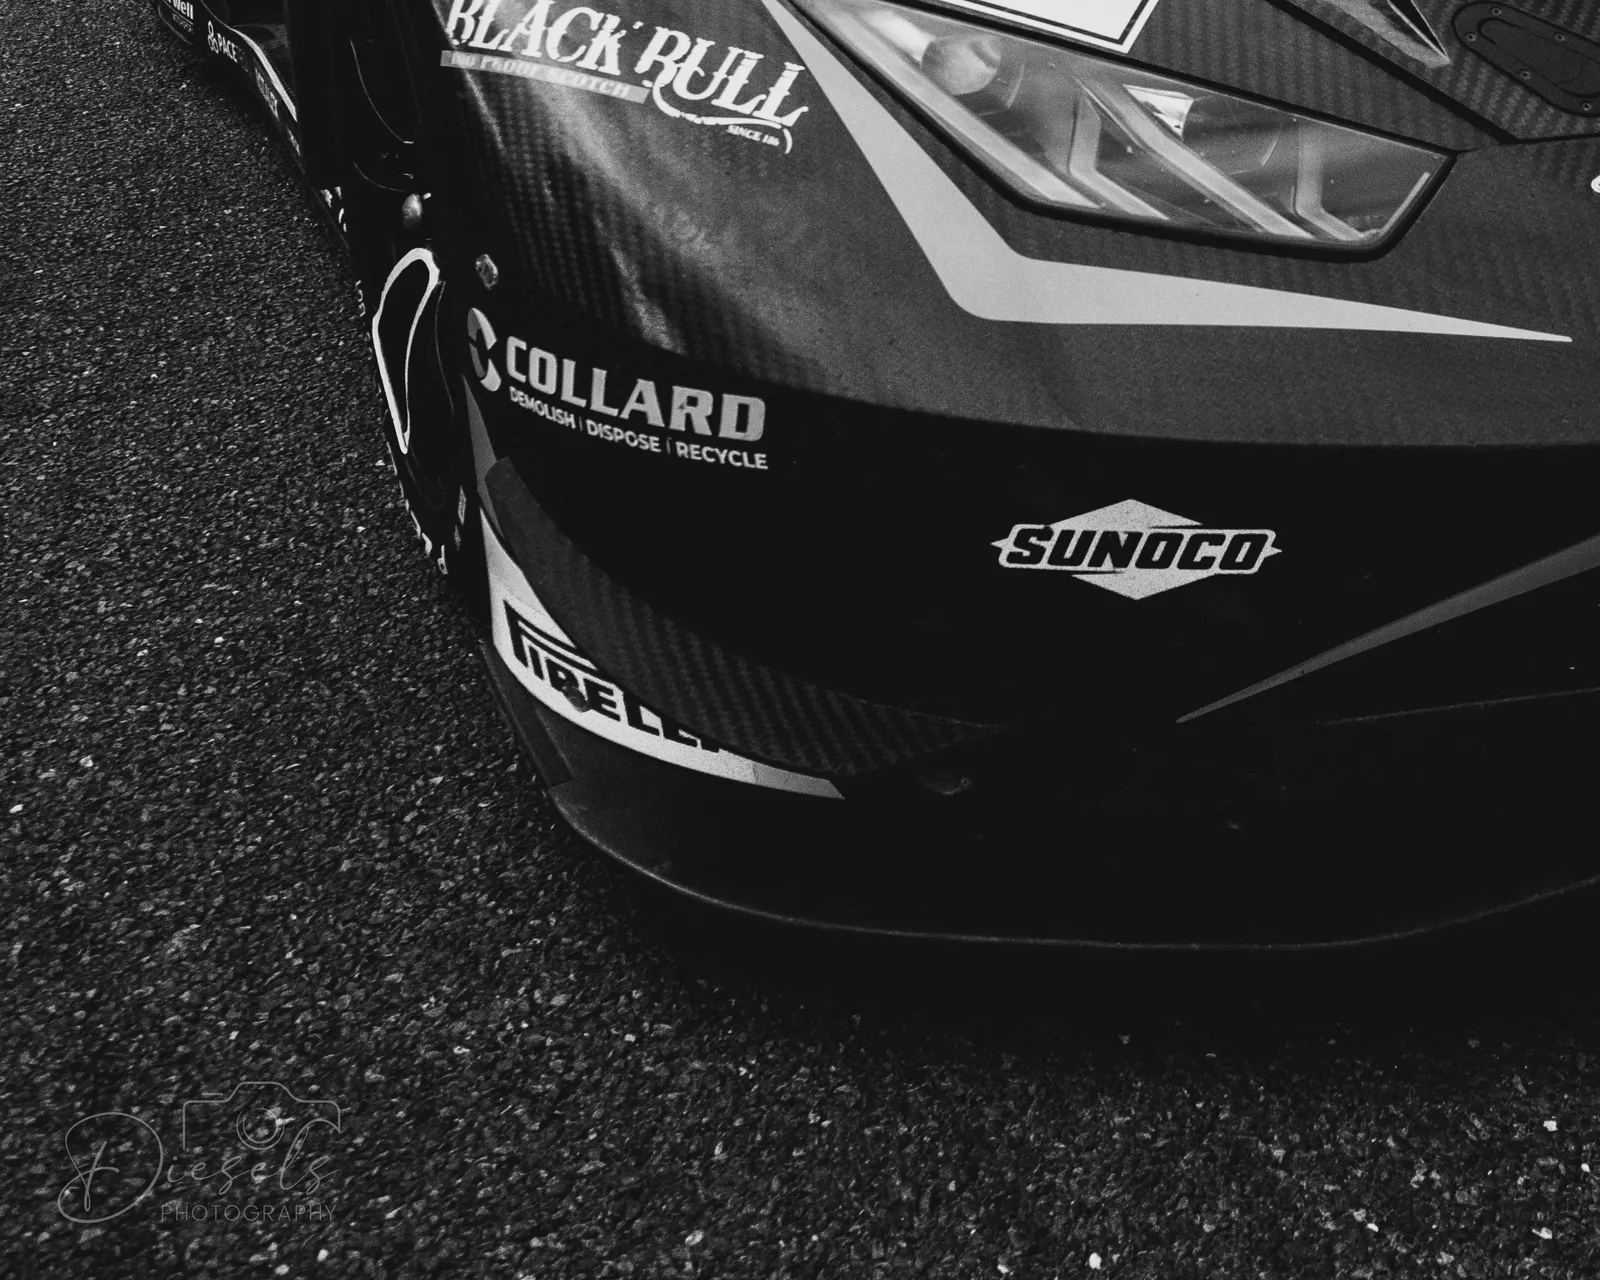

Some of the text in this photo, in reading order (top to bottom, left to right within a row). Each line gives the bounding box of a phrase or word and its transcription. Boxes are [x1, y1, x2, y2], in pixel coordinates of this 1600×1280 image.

[635, 24, 809, 128] BULL
[505, 334, 766, 443] COLLARD
[509, 383, 769, 471] DEMOLISH DISPOSE RECYCLE
[1006, 524, 1267, 572] SUNOCO
